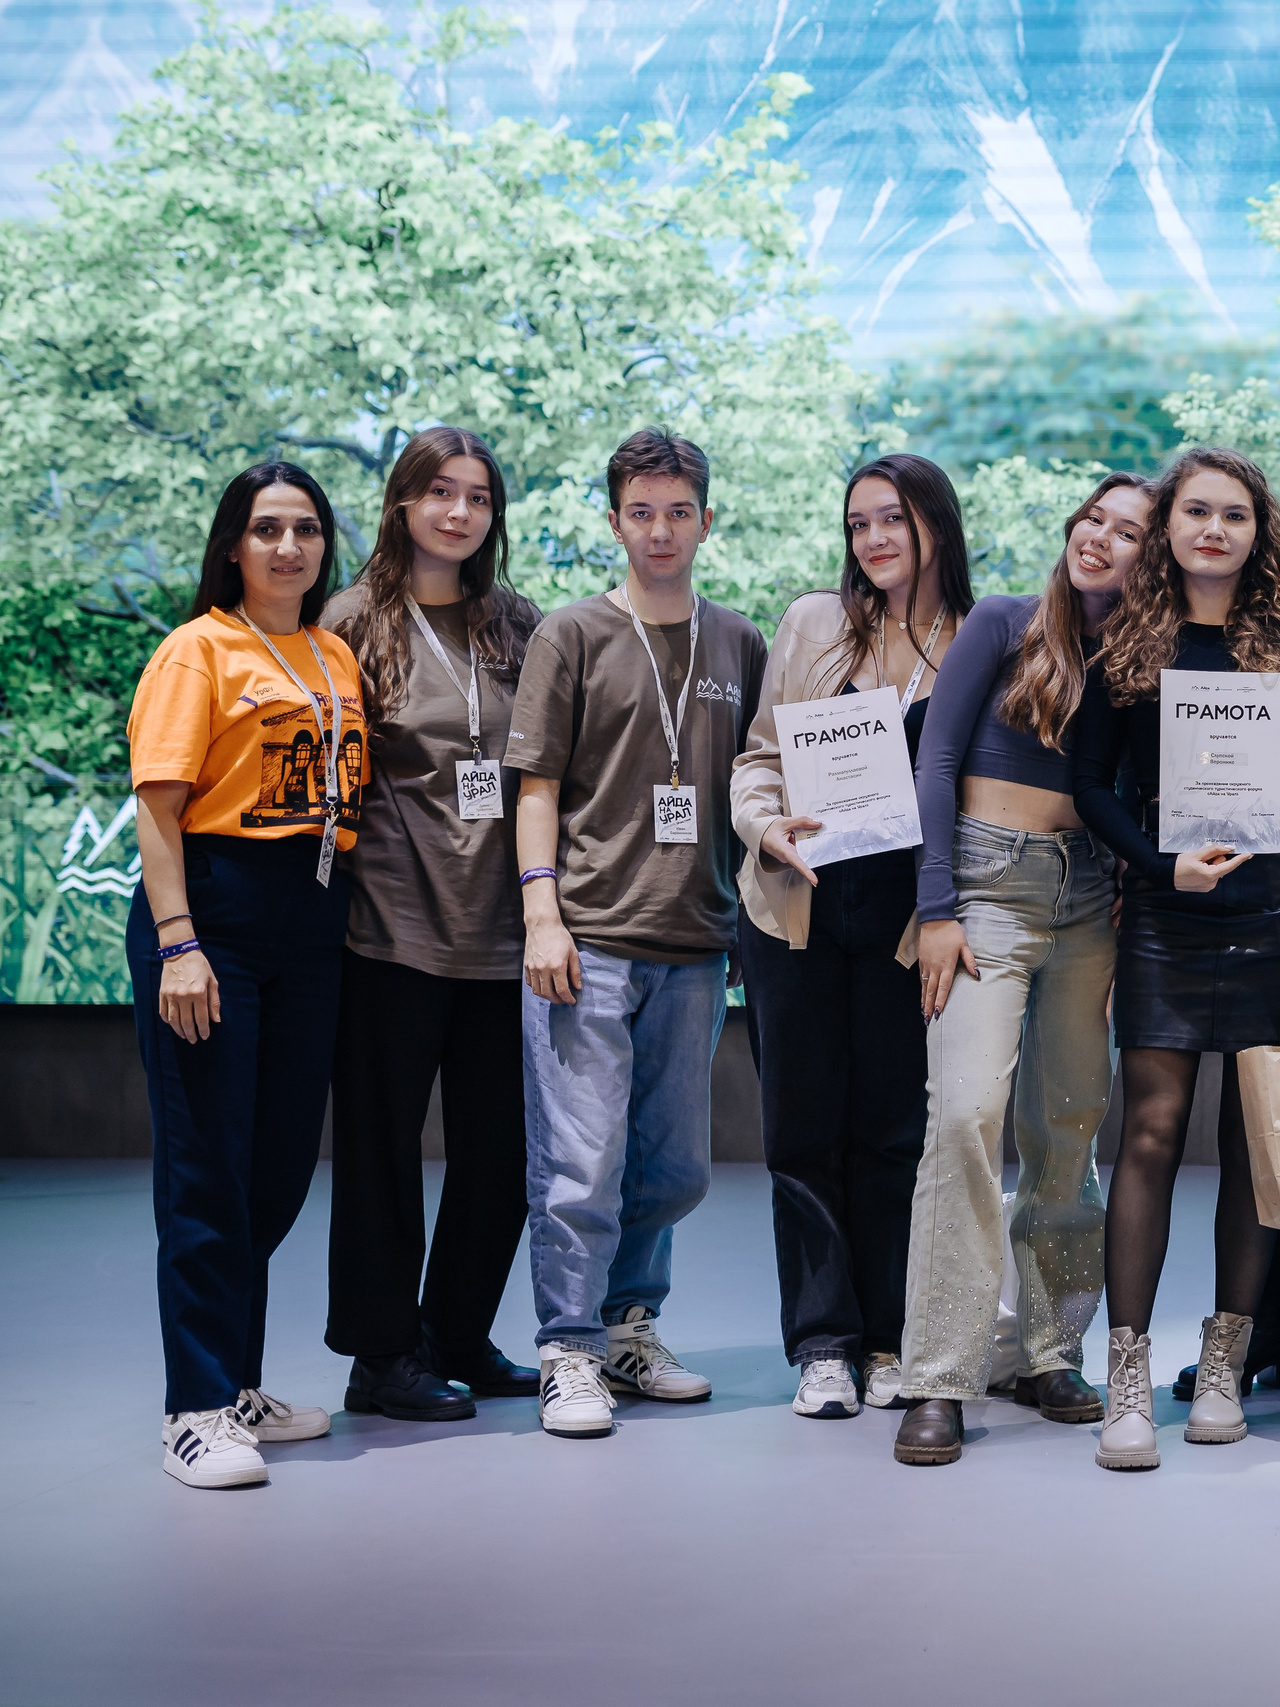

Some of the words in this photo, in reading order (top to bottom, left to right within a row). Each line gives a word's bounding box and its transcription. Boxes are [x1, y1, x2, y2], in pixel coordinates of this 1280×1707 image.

[1175, 702, 1271, 721] ГРАМОТА
[793, 719, 887, 749] ГРАМОТА
[832, 752, 858, 761] вручается
[461, 771, 497, 783] АЙДА
[462, 782, 476, 790] НА
[463, 781, 497, 801] УРАЛ
[658, 796, 692, 808] АЙДА
[659, 807, 692, 824] УРАЛ
